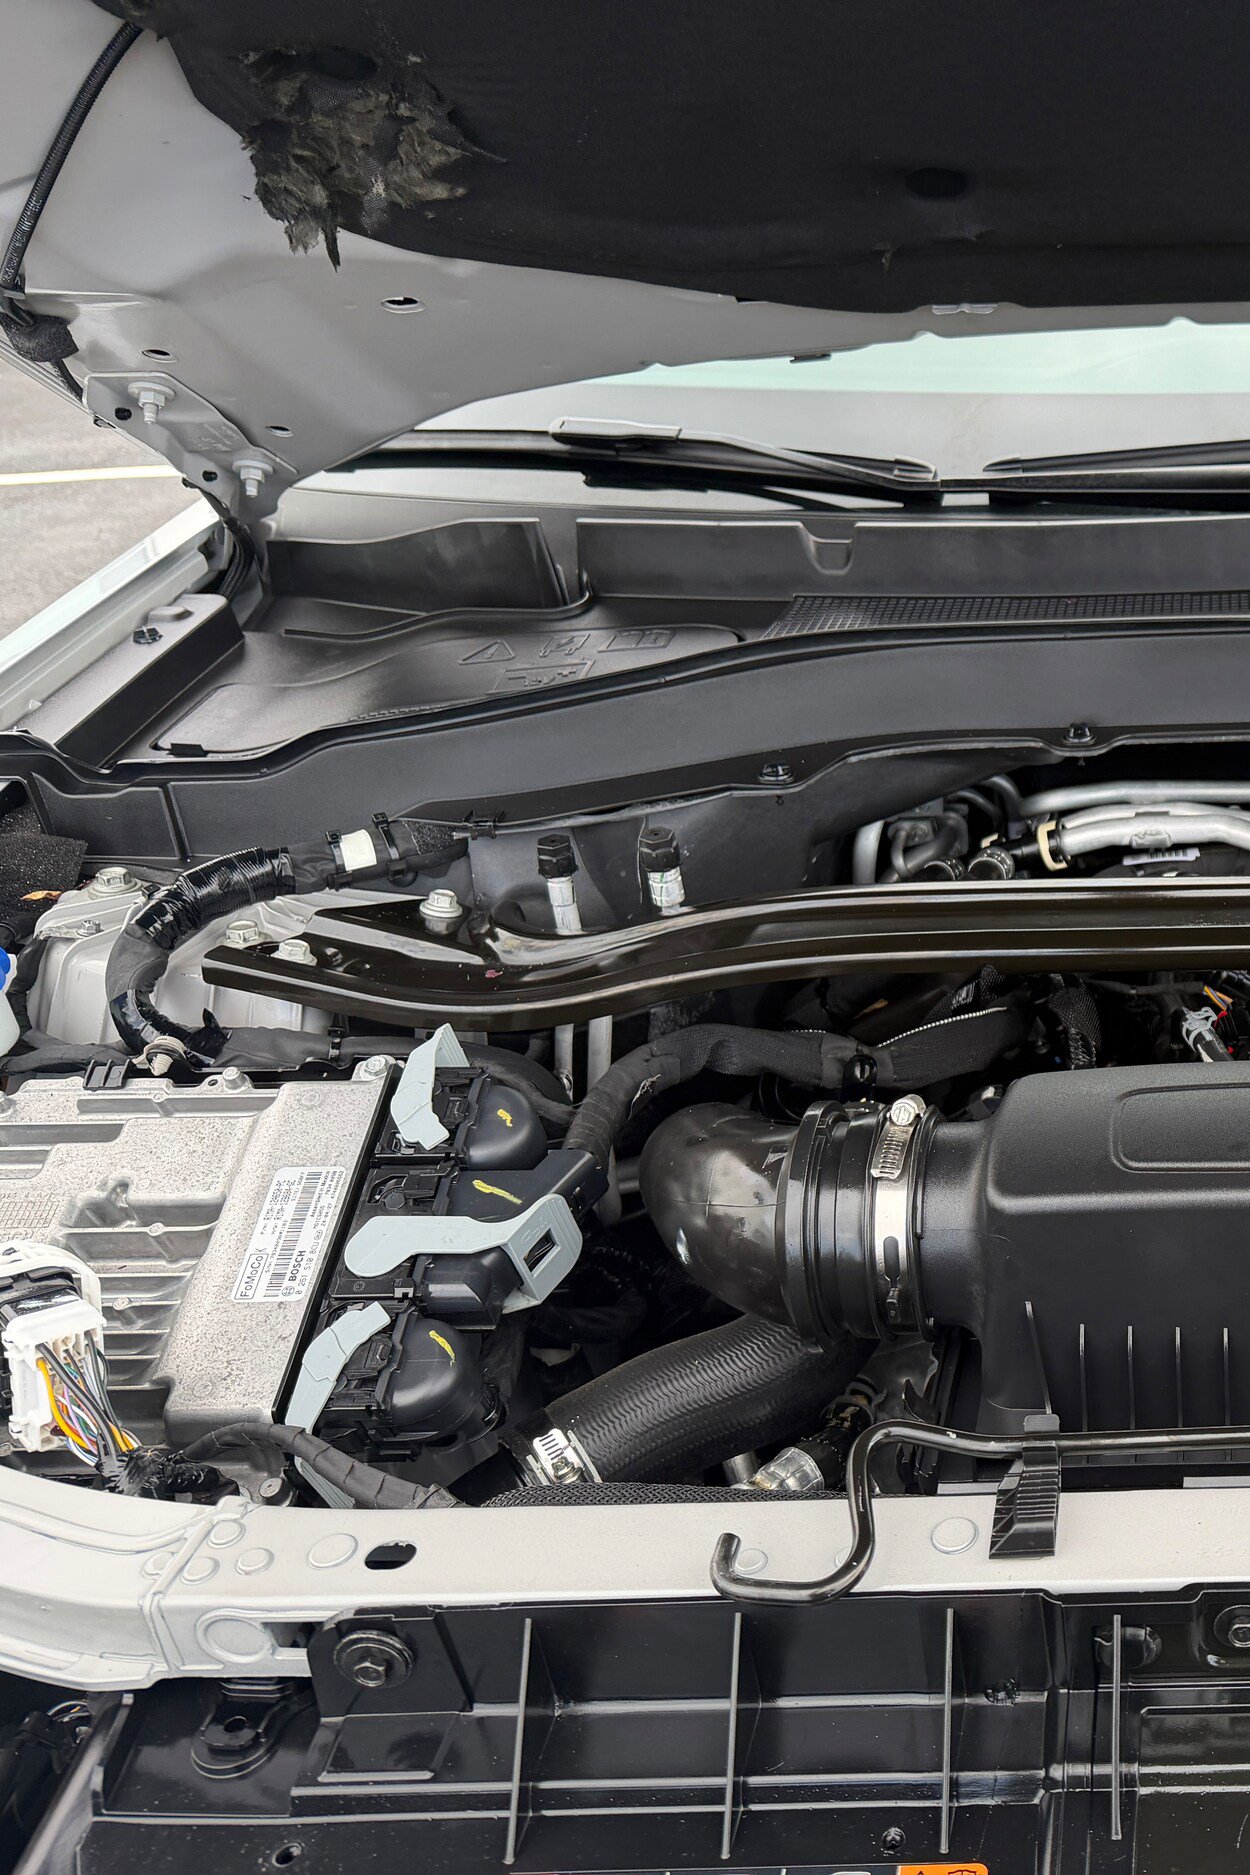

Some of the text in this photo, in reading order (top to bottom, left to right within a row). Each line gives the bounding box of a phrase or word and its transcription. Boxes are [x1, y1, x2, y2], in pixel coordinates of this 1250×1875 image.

[320, 1170, 330, 1186] Mexico
[239, 1255, 264, 1296] FoMoCo
[287, 1250, 306, 1281] BOSCH
